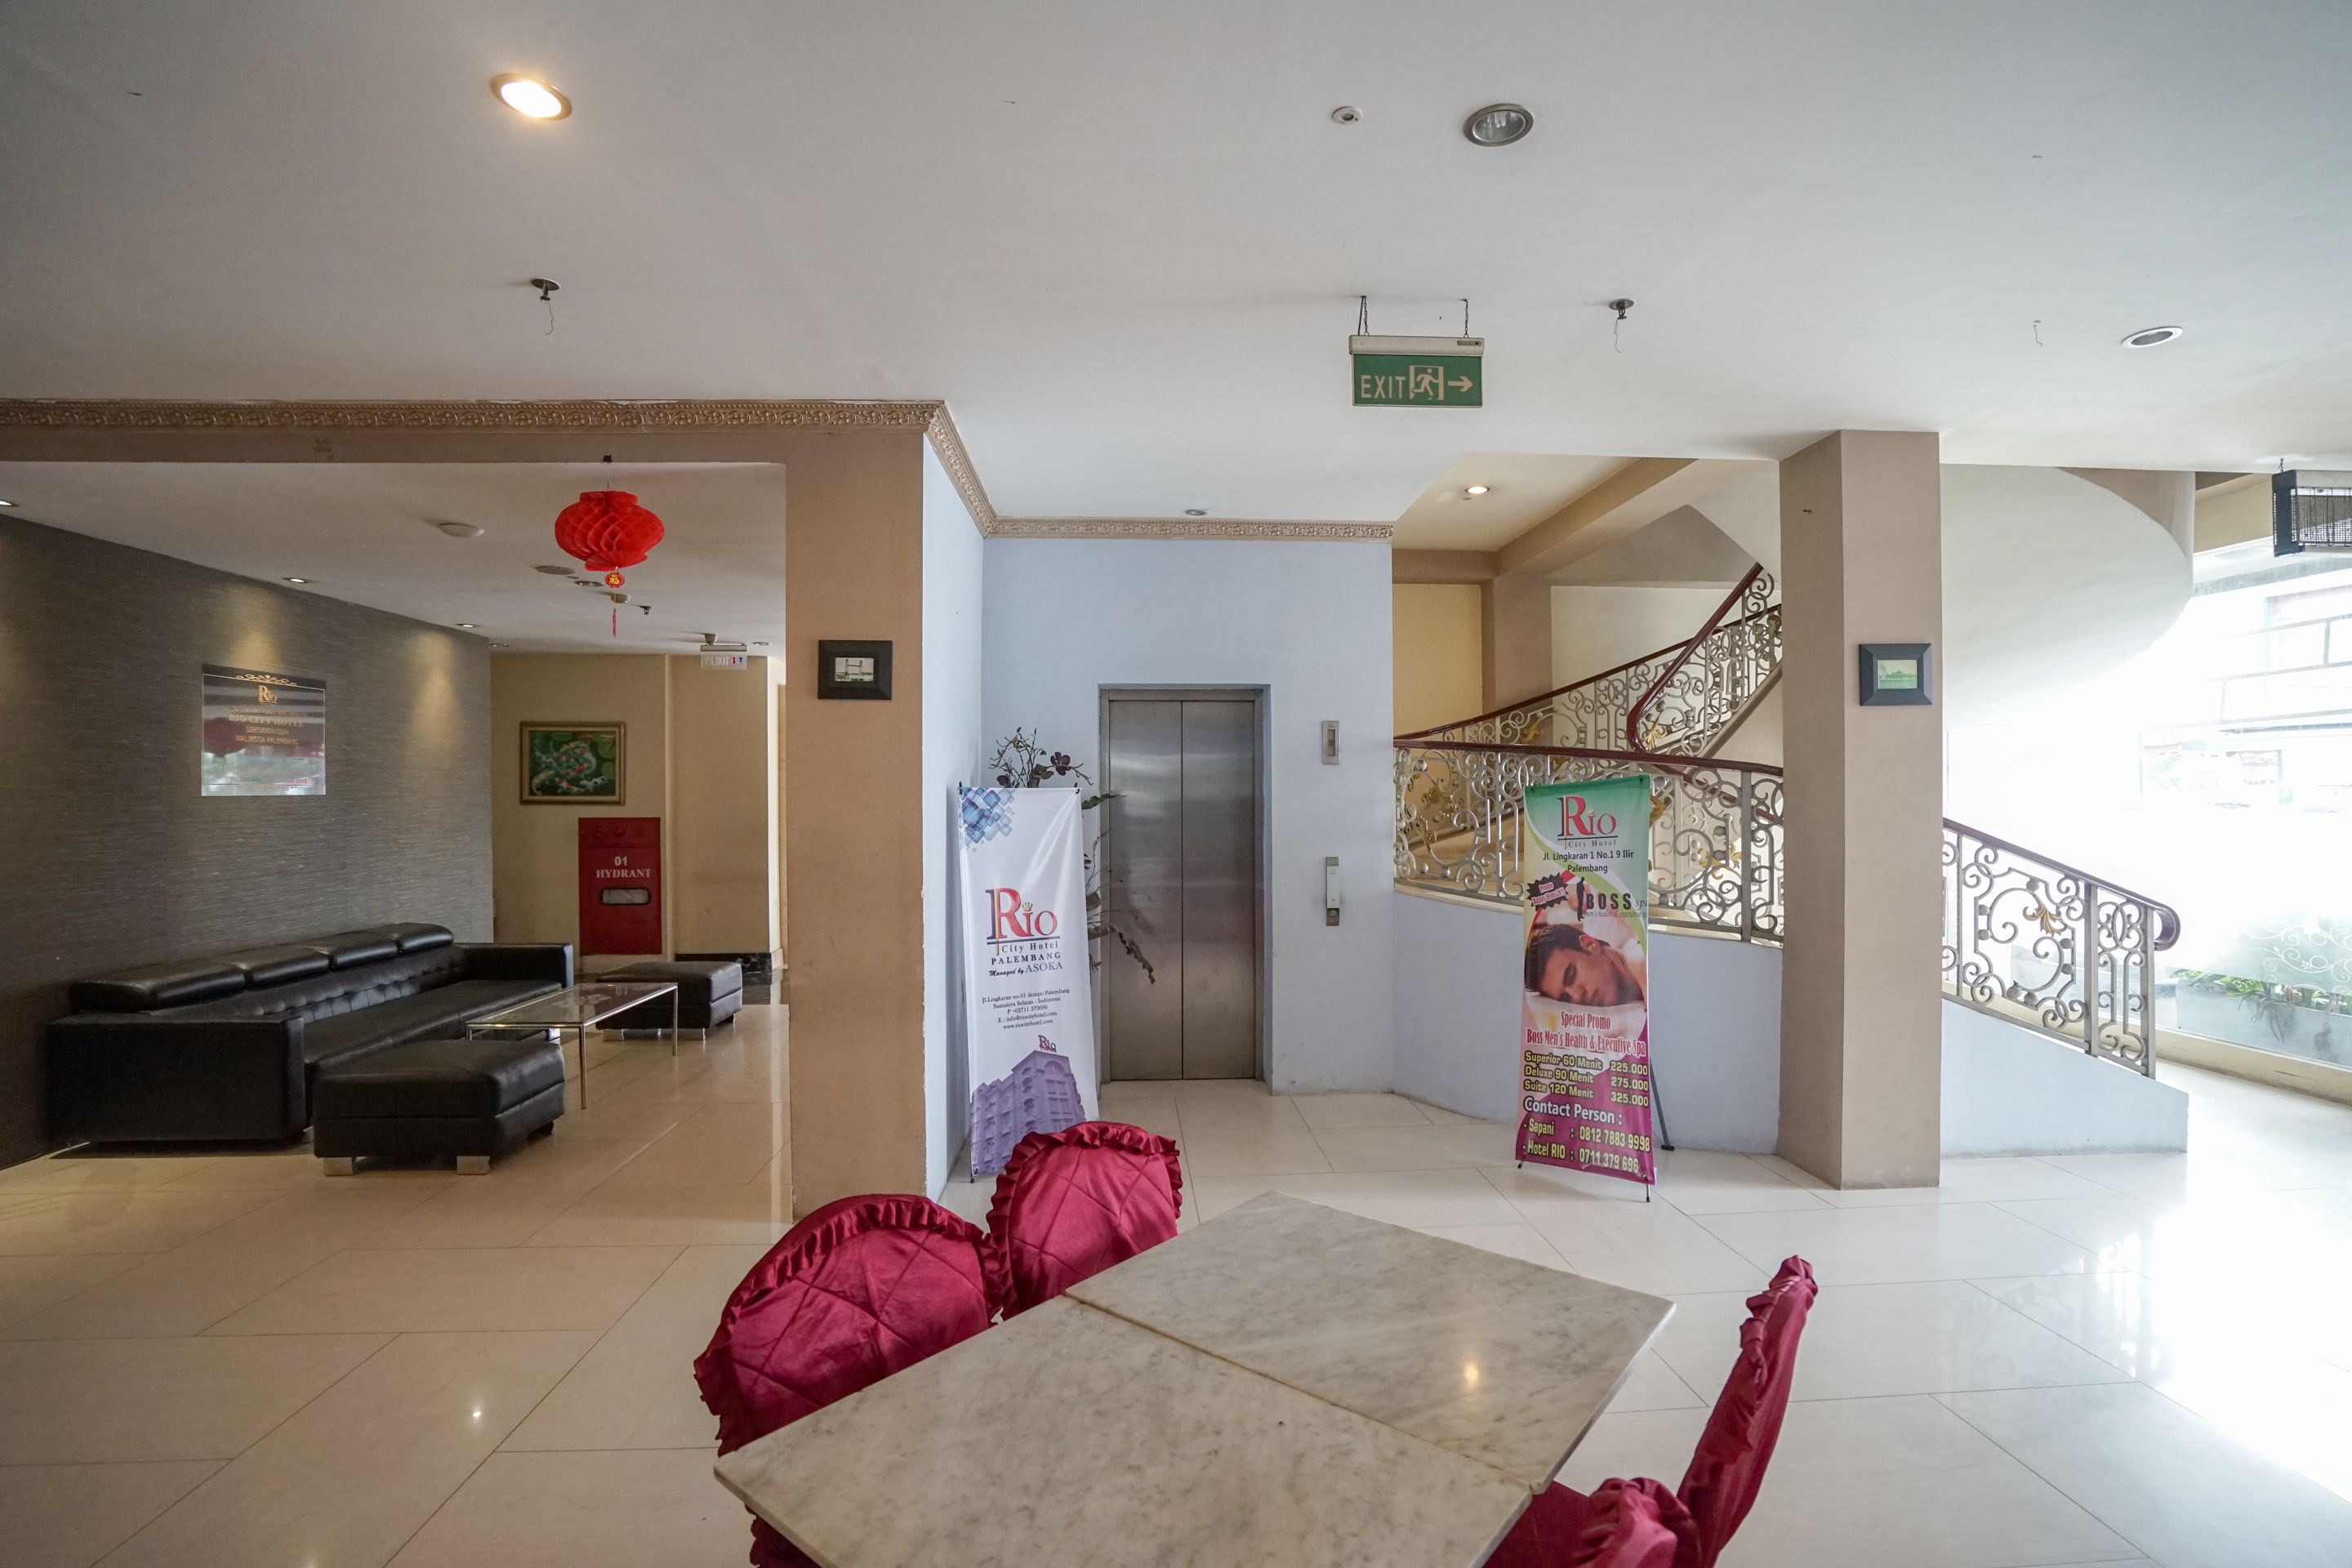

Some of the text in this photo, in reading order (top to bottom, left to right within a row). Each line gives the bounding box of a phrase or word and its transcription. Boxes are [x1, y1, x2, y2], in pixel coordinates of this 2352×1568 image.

[1360, 374, 1405, 399] EXIT
[258, 685, 278, 702] Rio
[229, 713, 246, 723] RIO
[248, 715, 273, 725] CITY
[1557, 795, 1617, 837] Rio
[614, 856, 627, 866] 01
[1552, 852, 1588, 862] Lingkaran
[1590, 851, 1595, 859] 1
[1597, 850, 1614, 859] No.1
[1615, 850, 1621, 858] 9
[1623, 849, 1634, 858] Ilir
[596, 869, 652, 878] HYDRANT
[1567, 864, 1608, 874] Palembang
[1586, 893, 1632, 910] BOSS
[985, 888, 1058, 940] Rio
[1001, 941, 1058, 953] City Hotel
[991, 951, 1062, 964] PALEMBANG
[988, 961, 1062, 977] Managed by ASOKA
[1003, 1019, 1054, 1029] www.riocityhotel.com
[1561, 1011, 1611, 1030] Special Promo
[1526, 1029, 1646, 1057] Boss Men's Health & Executive Spa
[1525, 1052, 1648, 1076] Superior 60 Menit 225.000
[1525, 1066, 1648, 1091] Deluxe 90 Menit 275.000
[1524, 1080, 1649, 1107] Suite 120 Menit 325.000
[1524, 1097, 1571, 1117] Contact
[1574, 1103, 1615, 1124] Person
[1529, 1118, 1555, 1136] Sapani
[1579, 1125, 1601, 1143] 0812
[1604, 1129, 1626, 1147] 7883
[1628, 1134, 1650, 1152] 9998
[1527, 1140, 1549, 1156] Hotel
[1551, 1143, 1566, 1159] RIO
[1579, 1148, 1601, 1165] 0711
[1603, 1153, 1620, 1169] 379
[1622, 1156, 1639, 1174] 696
